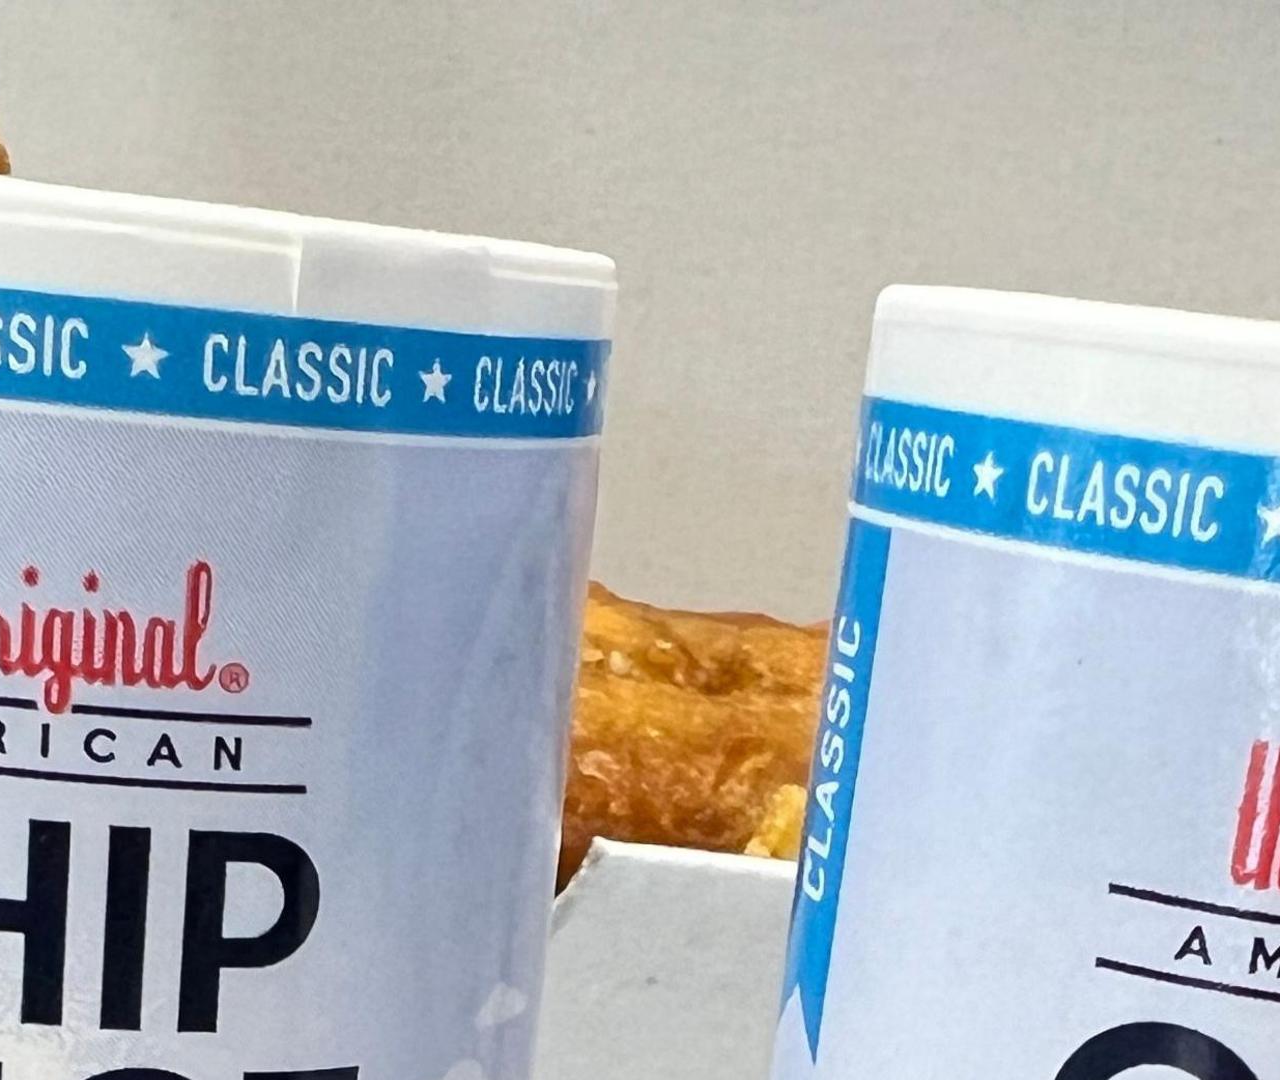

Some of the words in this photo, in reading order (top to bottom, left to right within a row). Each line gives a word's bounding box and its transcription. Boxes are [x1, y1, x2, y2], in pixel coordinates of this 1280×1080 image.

[202, 333, 394, 407] CLASSIC
[472, 355, 579, 416] CLASSIC
[864, 420, 955, 498] CLASSIC
[1026, 450, 1224, 542] CLASSIC
[803, 615, 862, 902] CLASSIC
